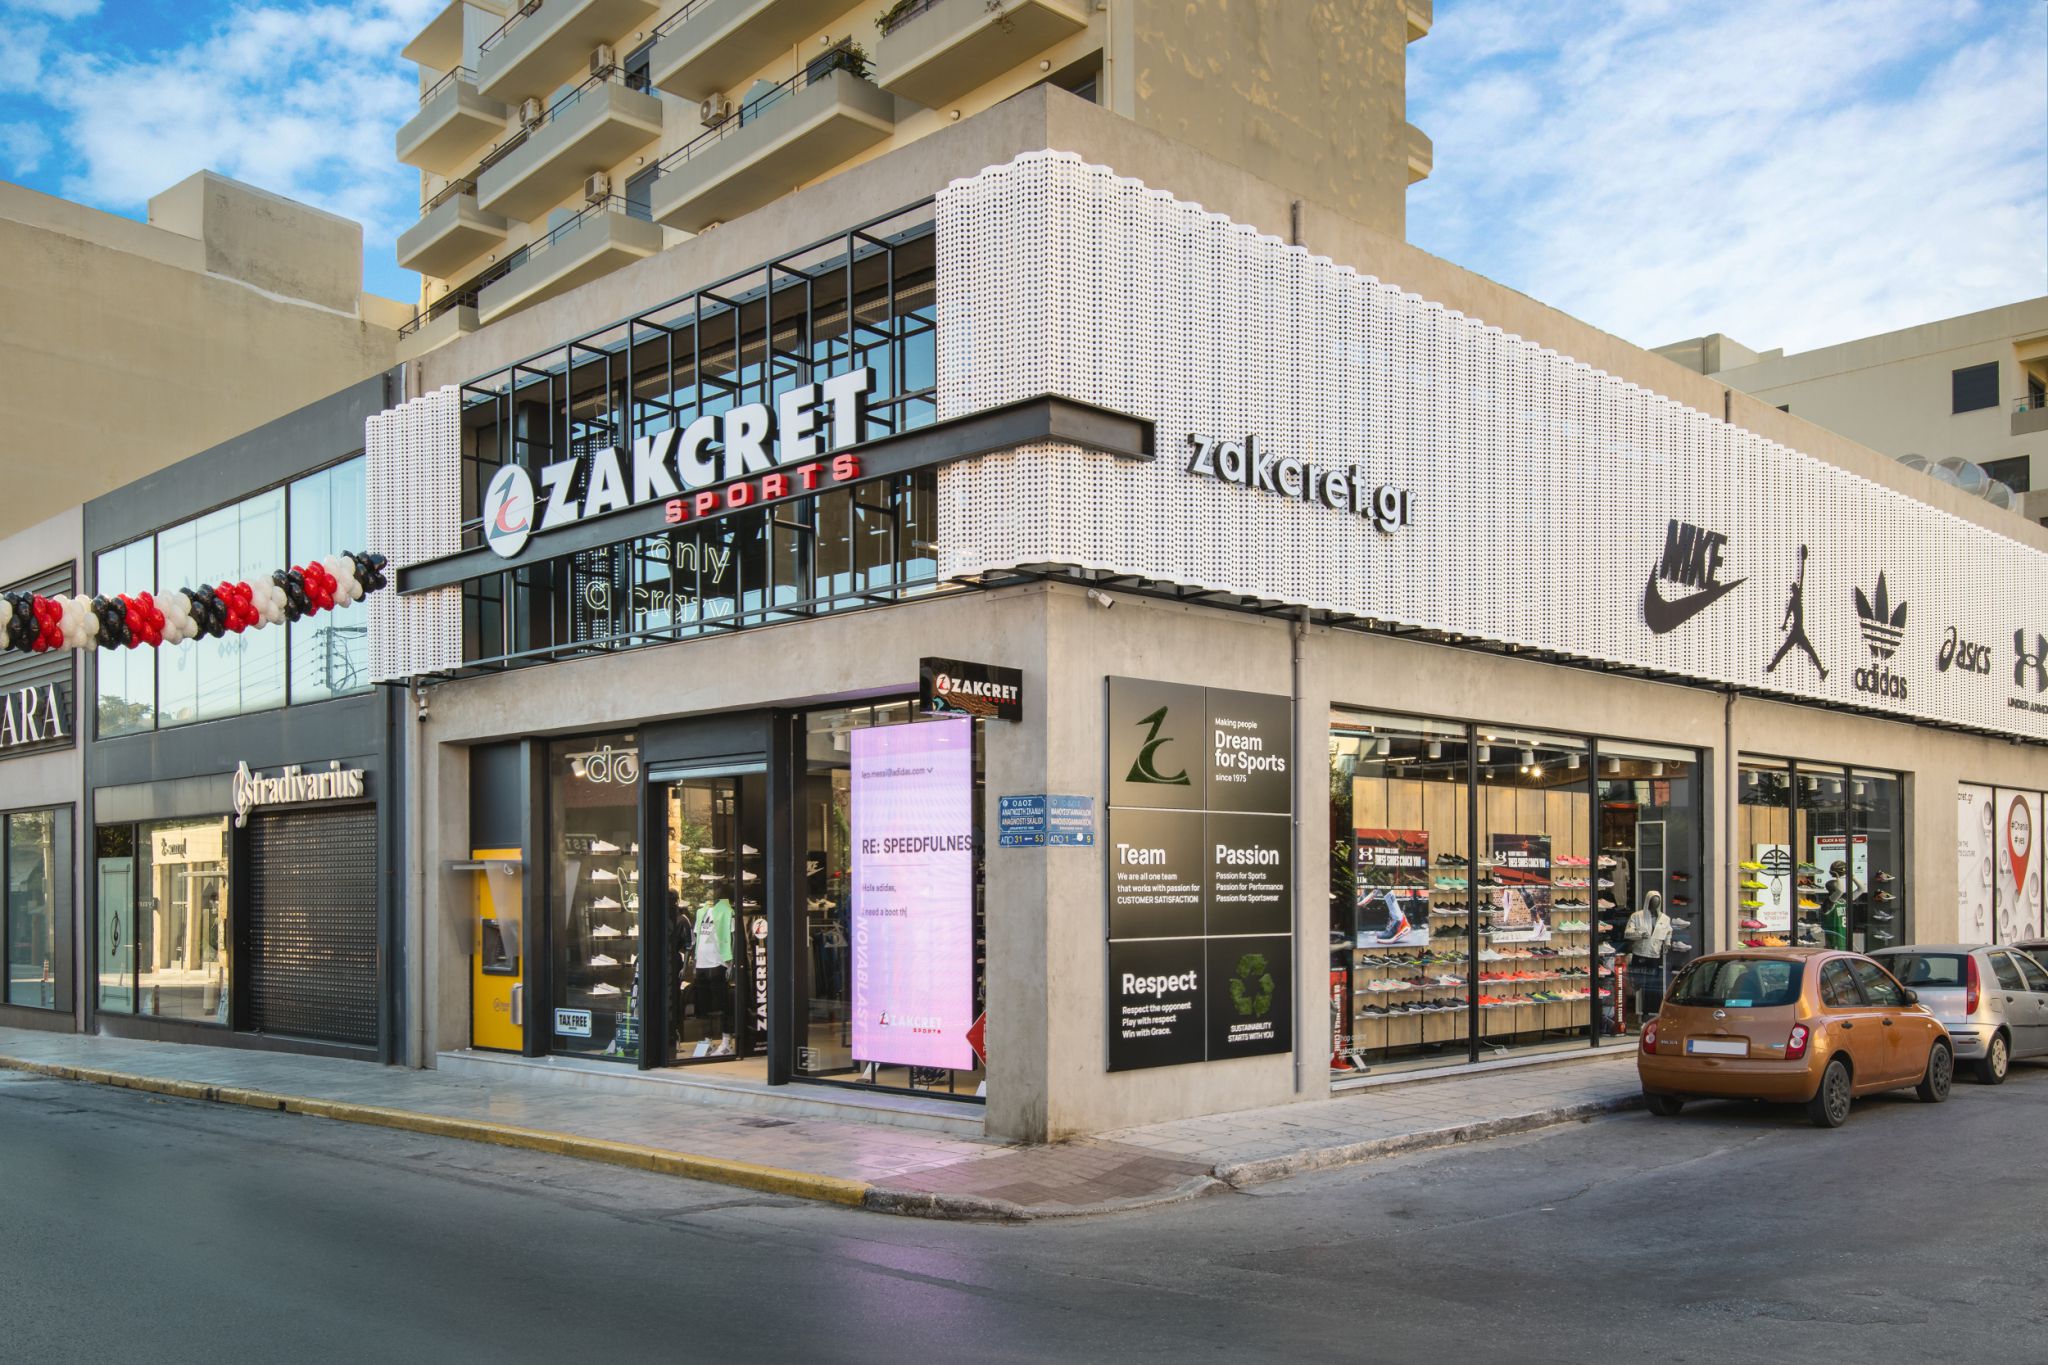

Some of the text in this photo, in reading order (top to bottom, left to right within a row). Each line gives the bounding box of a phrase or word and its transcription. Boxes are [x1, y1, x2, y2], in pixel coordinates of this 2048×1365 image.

[541, 367, 872, 530] ZAKCRET
[665, 453, 860, 524] SPORTS
[1186, 432, 1418, 533] zakcret.gr
[1660, 518, 1728, 590] NIKE
[1956, 638, 1991, 675] asics
[951, 677, 1018, 700] ZAKCRET
[1855, 663, 1908, 700] adidas
[1215, 718, 1258, 730] Making people
[1215, 730, 1262, 751] Dream
[1215, 749, 1285, 775] for Sports
[241, 760, 364, 808] stradivarius
[1215, 773, 1247, 783] since 1975
[1012, 799, 1032, 807] ΟΔΟΣ
[862, 839, 880, 854] RE:
[1117, 843, 1166, 865] Team
[1215, 844, 1279, 865] Passion
[1117, 872, 1128, 880] We
[1140, 872, 1148, 880] all
[1216, 871, 1267, 881] Passion for Sports
[1117, 883, 1200, 894] that works with passion for
[1216, 882, 1284, 891] Passion for Performance
[1117, 895, 1199, 905] CUSTOMER SATISFACTION
[1216, 894, 1239, 902] Passion
[1247, 893, 1280, 904] Sportswear
[857, 916, 869, 1033] NOVABLAST
[756, 945, 768, 1031] ZAKCRET
[1122, 970, 1198, 998] Respect
[1122, 1001, 1192, 1015] Respect the opponent
[559, 1014, 587, 1027] TAX FREE
[1122, 1014, 1176, 1028] Play with respect
[1230, 1021, 1272, 1033] SUSTAINABILITY
[1122, 1026, 1172, 1038] Win with Grace.
[1227, 1030, 1274, 1042] STARTS WITH YOU
